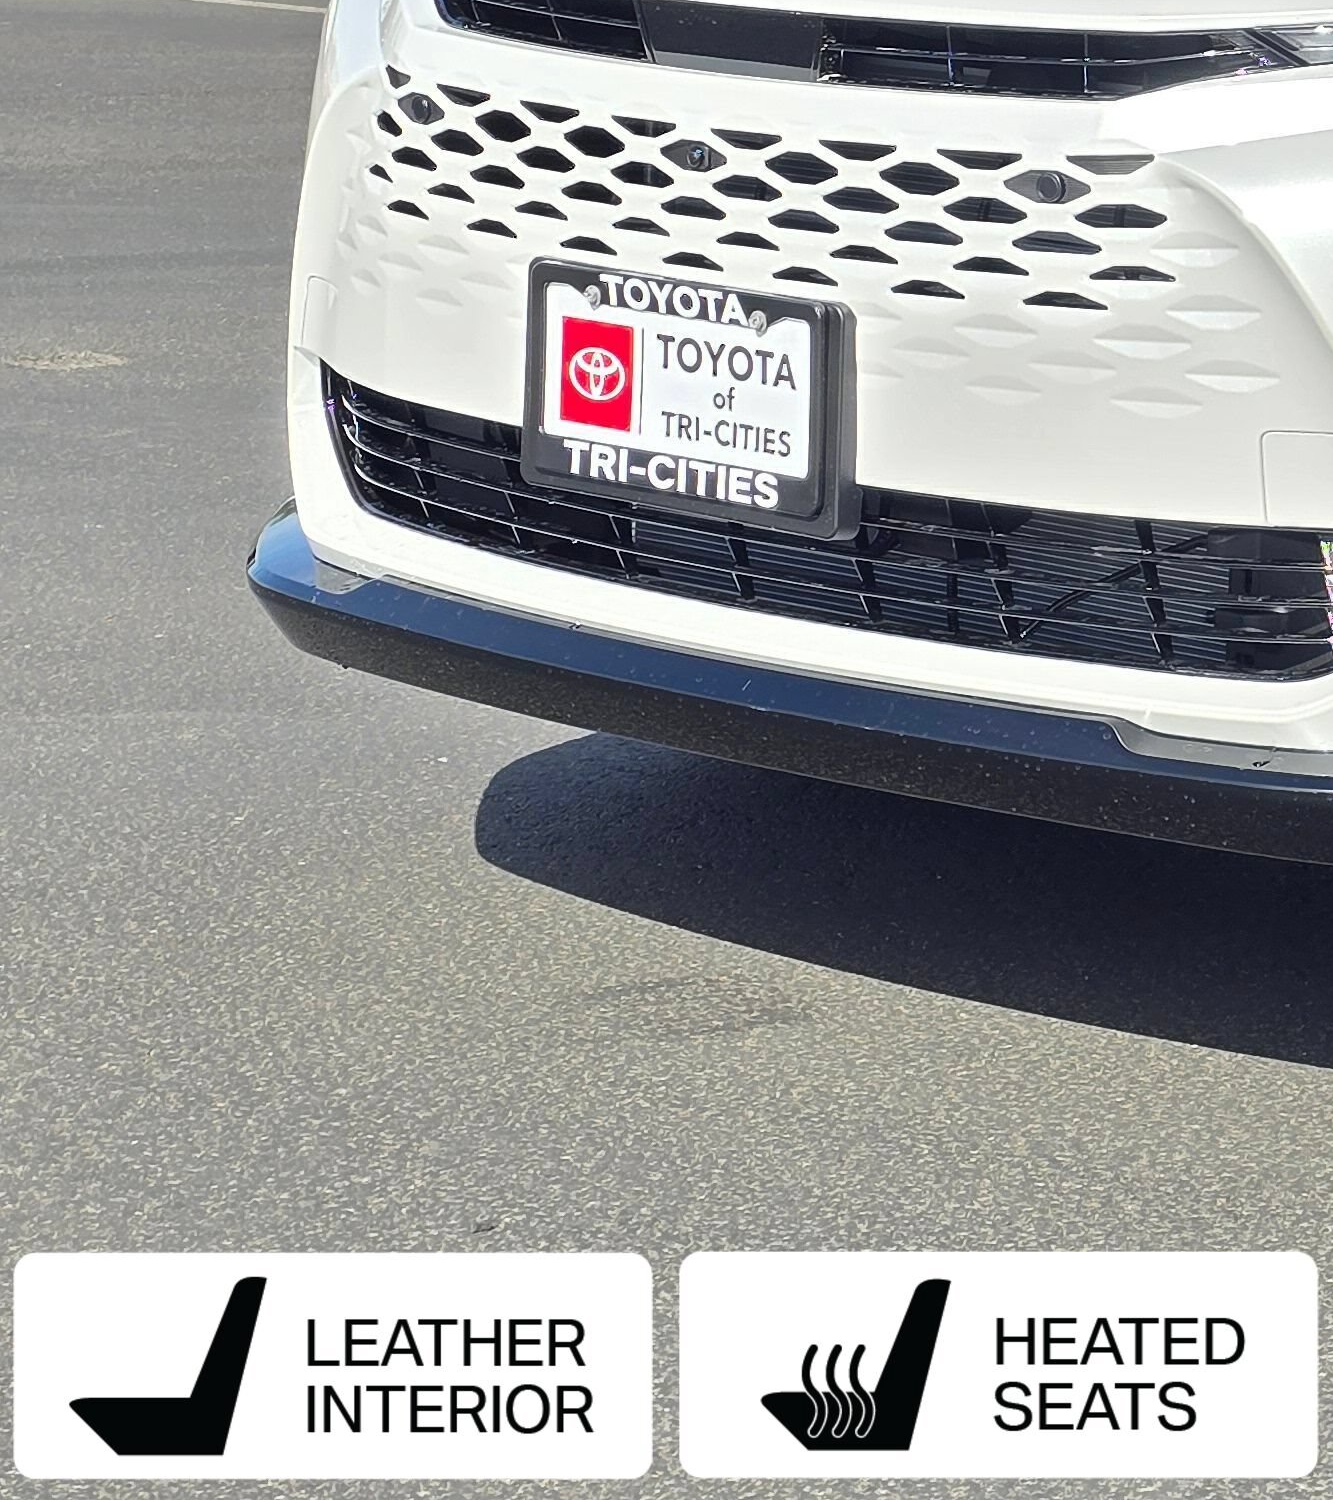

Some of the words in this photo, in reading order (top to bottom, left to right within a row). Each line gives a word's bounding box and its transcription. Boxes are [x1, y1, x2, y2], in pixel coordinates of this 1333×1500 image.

[600, 274, 749, 327] TOYOTA
[656, 334, 797, 391] TOYOTA
[712, 387, 736, 412] of
[661, 411, 791, 457] TRI-CITIES
[563, 439, 779, 508] TRI-CITIES
